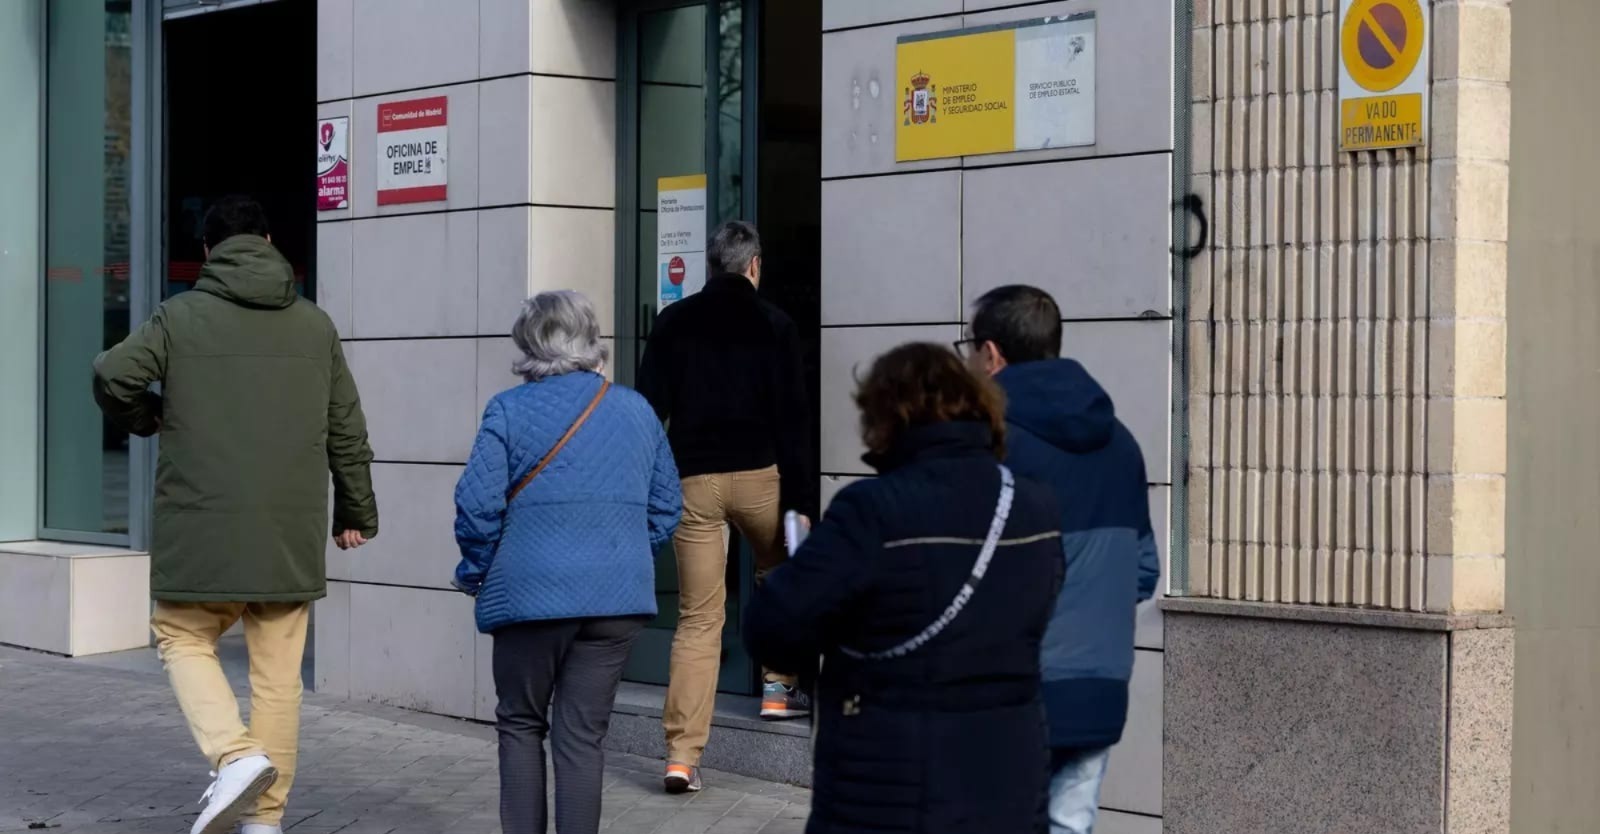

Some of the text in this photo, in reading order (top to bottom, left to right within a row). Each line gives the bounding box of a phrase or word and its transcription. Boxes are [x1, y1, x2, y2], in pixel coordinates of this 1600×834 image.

[942, 83, 977, 94] MINISTERIO
[1029, 82, 1052, 91] SERVICIO
[1029, 86, 1081, 99] DE EMPLEO ESTATAL
[942, 93, 977, 105] DE EMPLEO
[392, 111, 418, 120] Comunidad
[418, 110, 425, 118] de
[425, 107, 442, 116] Madrid
[942, 100, 1008, 116] Y SEGURIDAD SOCIAL
[1366, 100, 1397, 119] VADO
[1345, 122, 1417, 144] PERMANENTE
[386, 141, 438, 159] OFICINA DE
[393, 157, 431, 175] EMPLE
[318, 185, 345, 197] alarma
